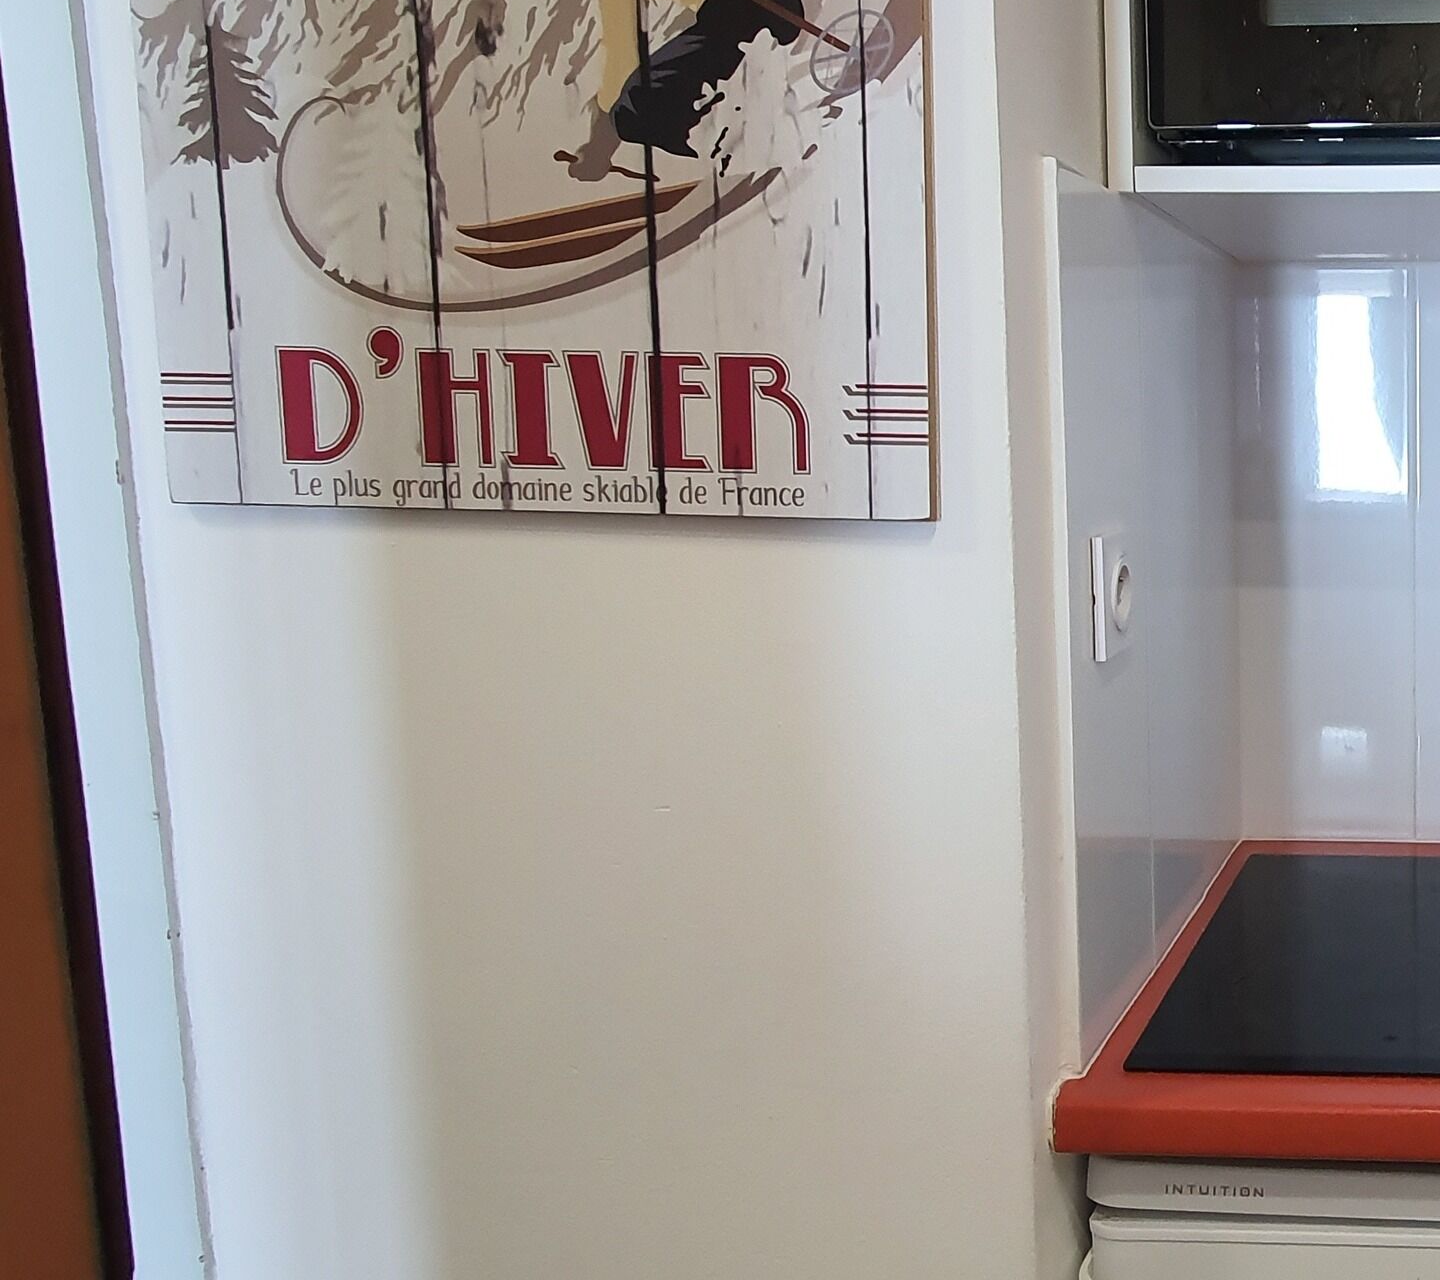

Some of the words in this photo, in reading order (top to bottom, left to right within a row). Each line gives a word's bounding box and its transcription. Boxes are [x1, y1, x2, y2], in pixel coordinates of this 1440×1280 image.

[274, 325, 812, 476] D'HIVER
[289, 467, 323, 497] Le
[332, 469, 382, 506] plus
[392, 471, 462, 507] grand
[471, 472, 573, 503] domaine
[678, 476, 708, 505] de
[716, 477, 806, 507] France
[1164, 1183, 1265, 1199] INTUITION
